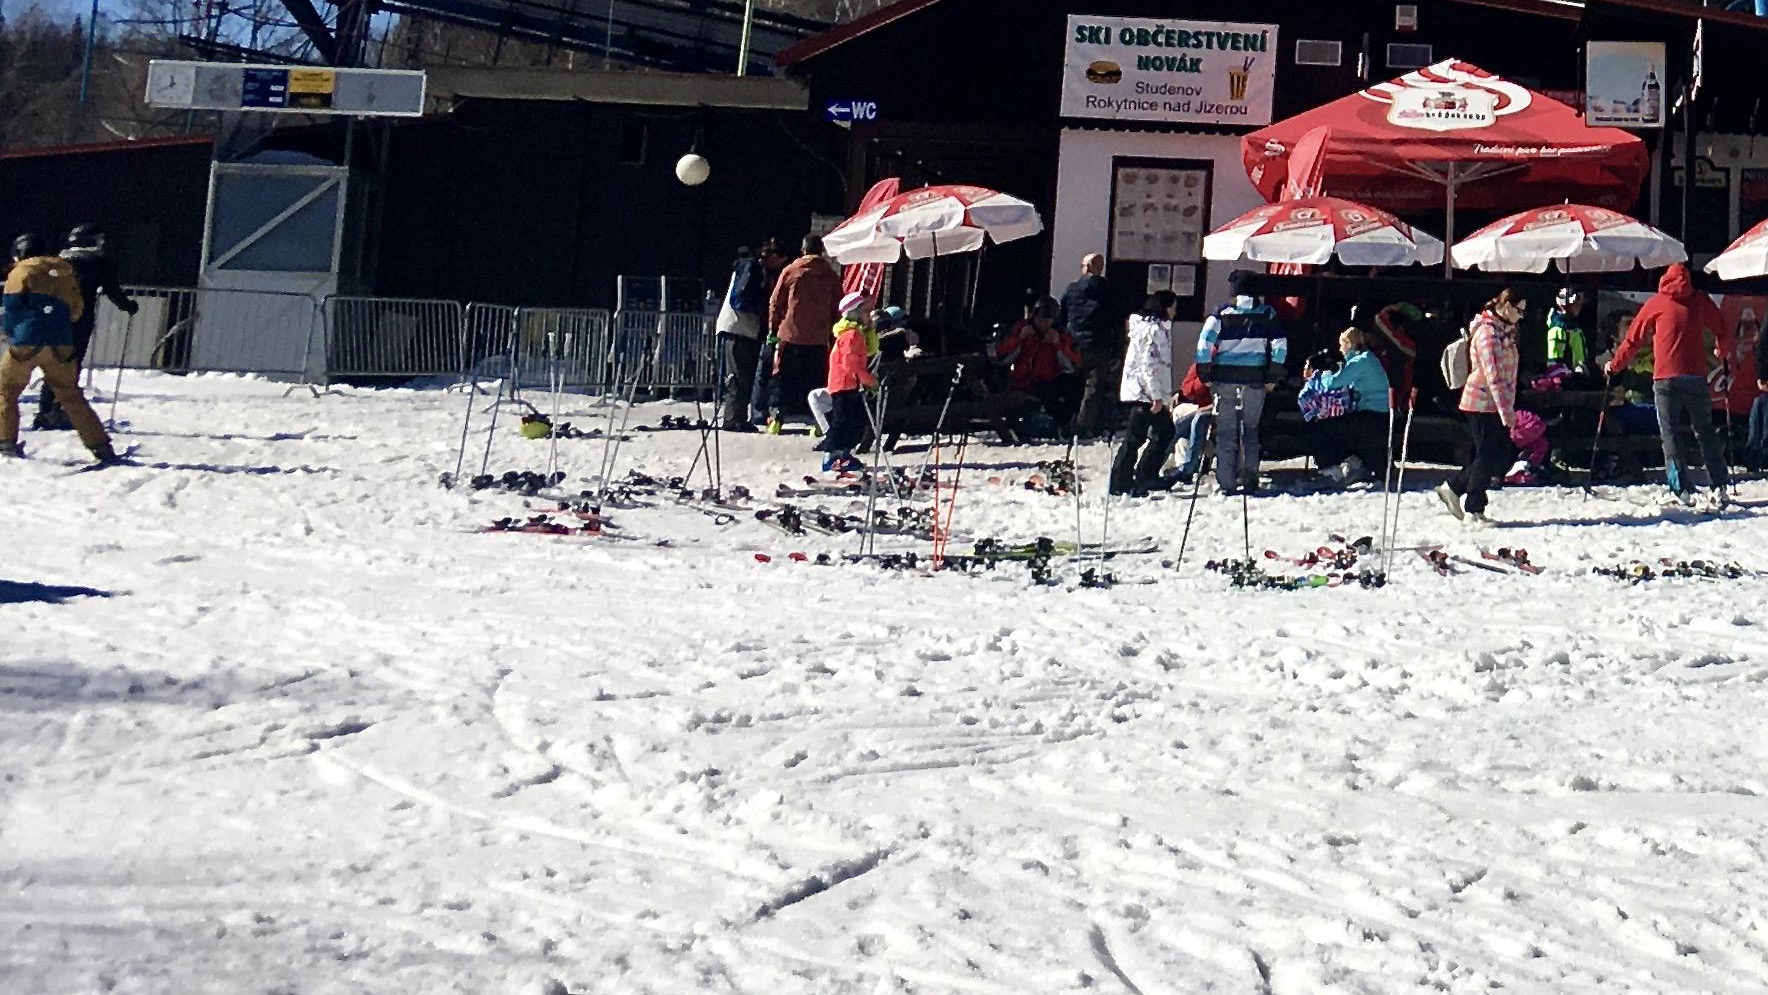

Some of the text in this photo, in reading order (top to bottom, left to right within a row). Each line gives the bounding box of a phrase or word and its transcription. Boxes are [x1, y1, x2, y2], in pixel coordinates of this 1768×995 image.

[1075, 24, 1268, 52] SKI OBČERSTVENÍ
[1137, 53, 1203, 73] NOVÁK
[1135, 81, 1203, 96] Studenov
[851, 101, 877, 119] WC
[1086, 95, 1248, 115] Rokytnice nad Jizerou
